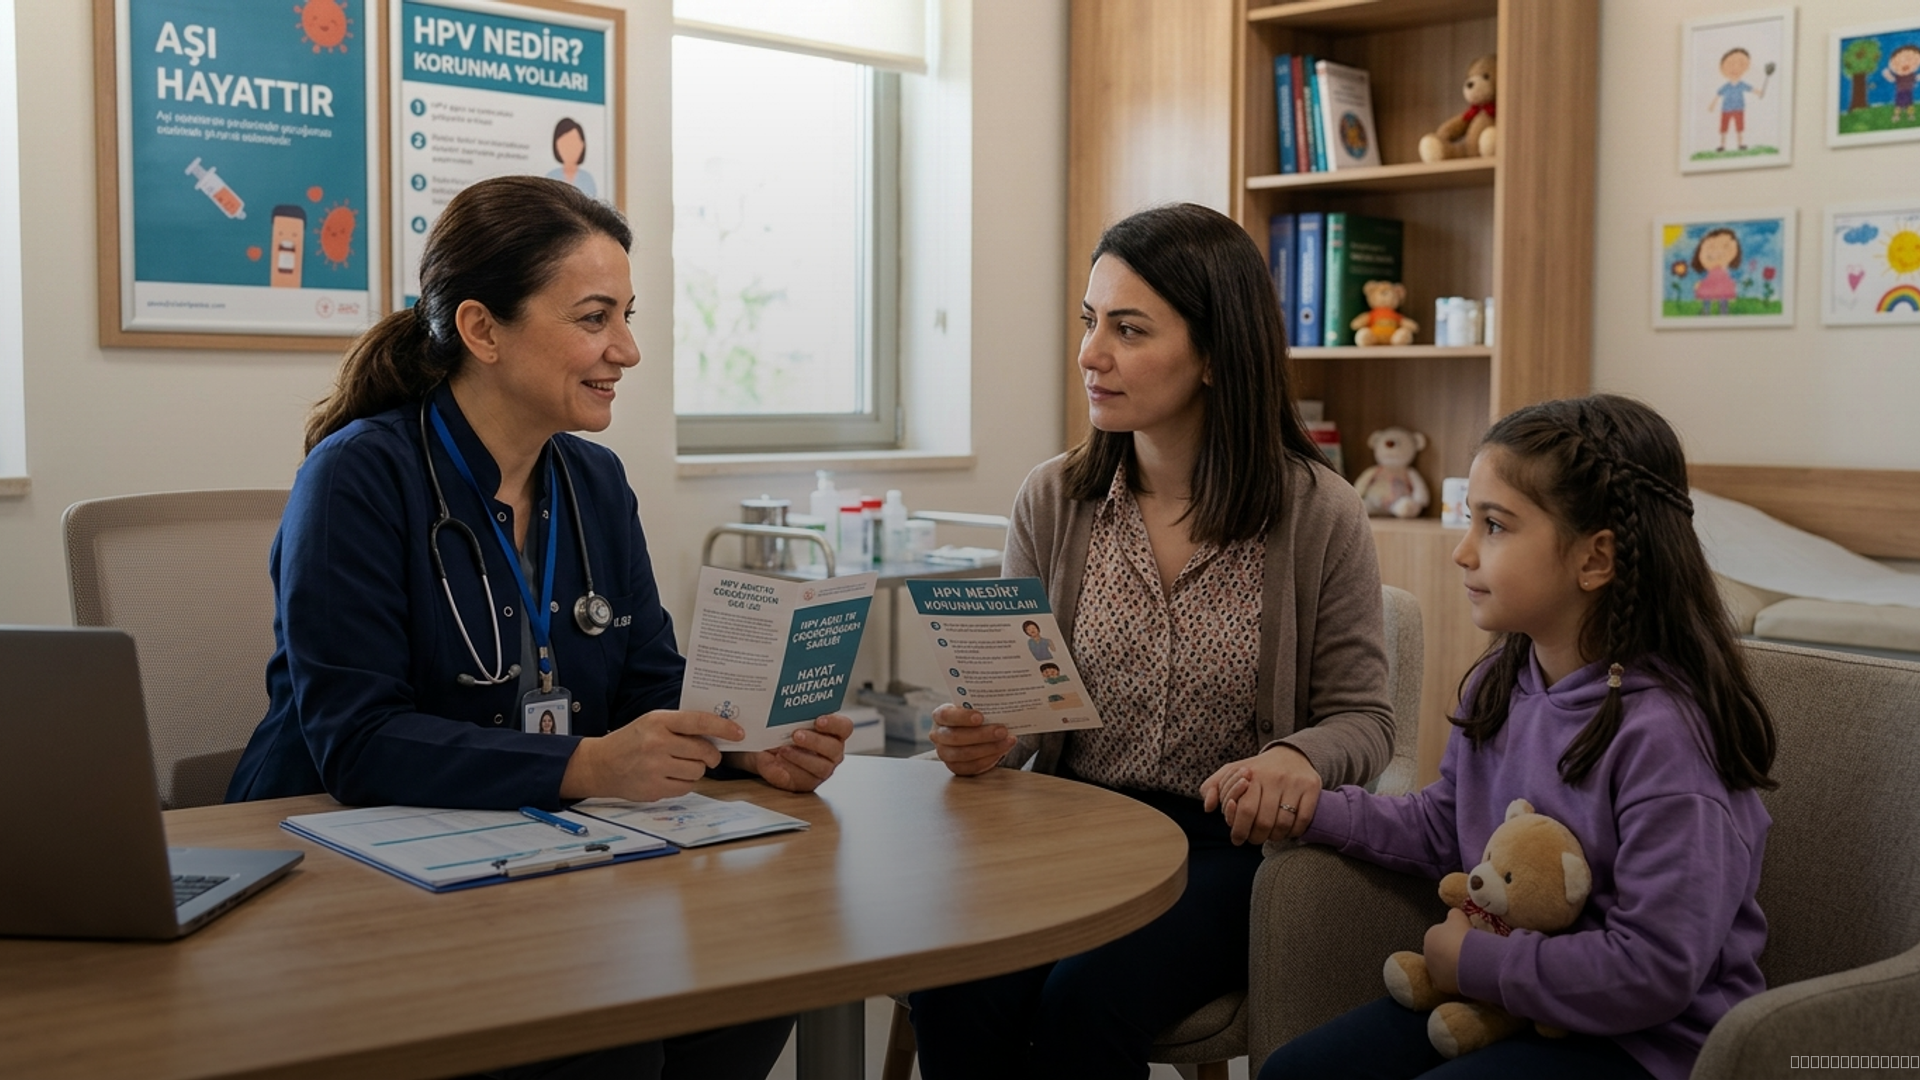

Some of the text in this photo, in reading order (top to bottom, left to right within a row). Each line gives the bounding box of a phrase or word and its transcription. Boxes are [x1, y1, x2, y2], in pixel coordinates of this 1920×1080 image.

[155, 21, 217, 66] AŞI
[413, 15, 584, 67] HPV NEDİR?
[157, 66, 334, 118] HAYATTIR
[413, 51, 589, 92] KORUNMA YOLLARI
[797, 663, 836, 681] HAYAT
